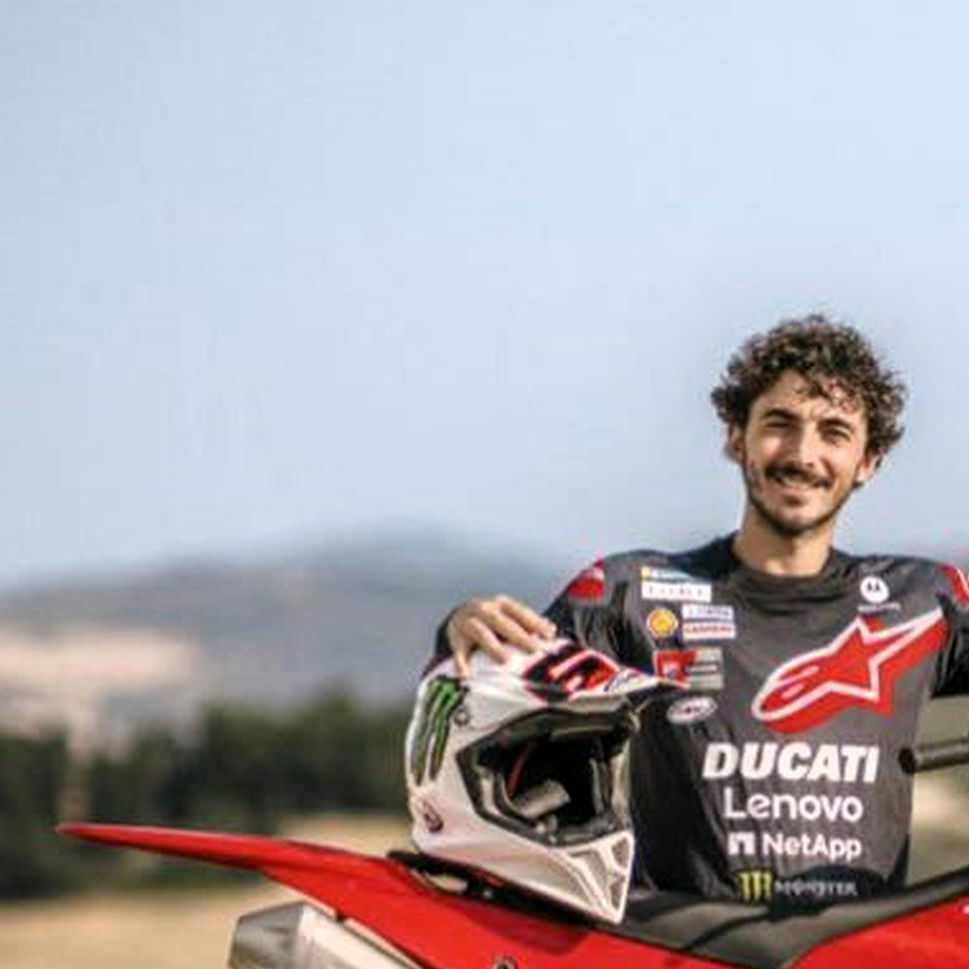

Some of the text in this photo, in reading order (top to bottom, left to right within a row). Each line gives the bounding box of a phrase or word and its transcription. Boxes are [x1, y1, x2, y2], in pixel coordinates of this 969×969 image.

[702, 742, 879, 783] DUCATI
[724, 786, 863, 822] Lenovo
[762, 833, 861, 861] NetApp
